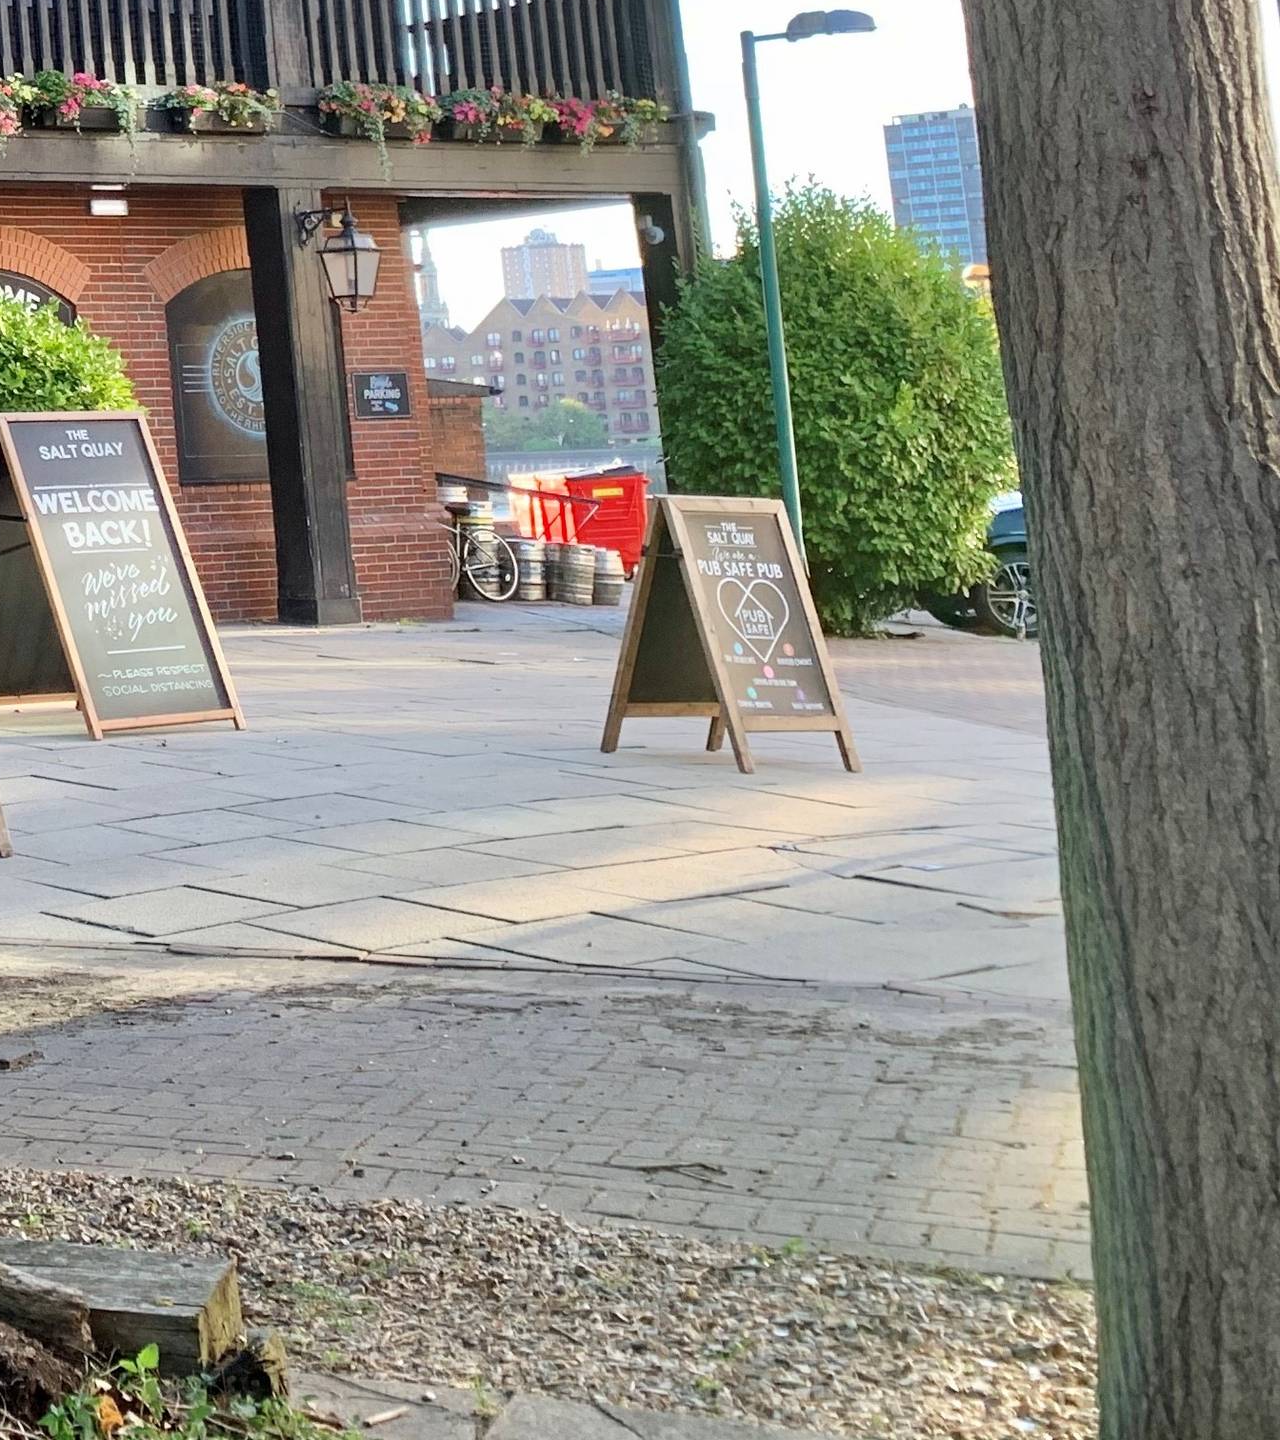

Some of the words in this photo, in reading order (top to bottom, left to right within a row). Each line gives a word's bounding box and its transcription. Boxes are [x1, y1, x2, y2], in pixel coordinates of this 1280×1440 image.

[211, 321, 252, 376] RIVERSIDE
[224, 337, 248, 378] SALT
[364, 389, 401, 400] PARKING
[65, 429, 90, 441] THE
[39, 444, 78, 460] SALT
[81, 441, 123, 458] QUAY
[32, 488, 160, 515] WELCOME
[62, 519, 153, 548] BACK!
[720, 522, 737, 532] THE
[707, 531, 728, 544] SALT
[731, 532, 755, 545] QUAY
[697, 559, 722, 576] PUB
[723, 561, 755, 577] SAFE
[756, 563, 783, 579] PUB
[81, 562, 140, 596] We've
[84, 566, 171, 621] missed
[128, 606, 178, 642] you
[742, 609, 766, 623] PUB
[745, 623, 769, 635] SAFE
[112, 667, 154, 679] PLEASE
[156, 663, 205, 676] RESPECT
[102, 683, 148, 697] SOCIAL
[150, 679, 214, 692] DISTANCING
